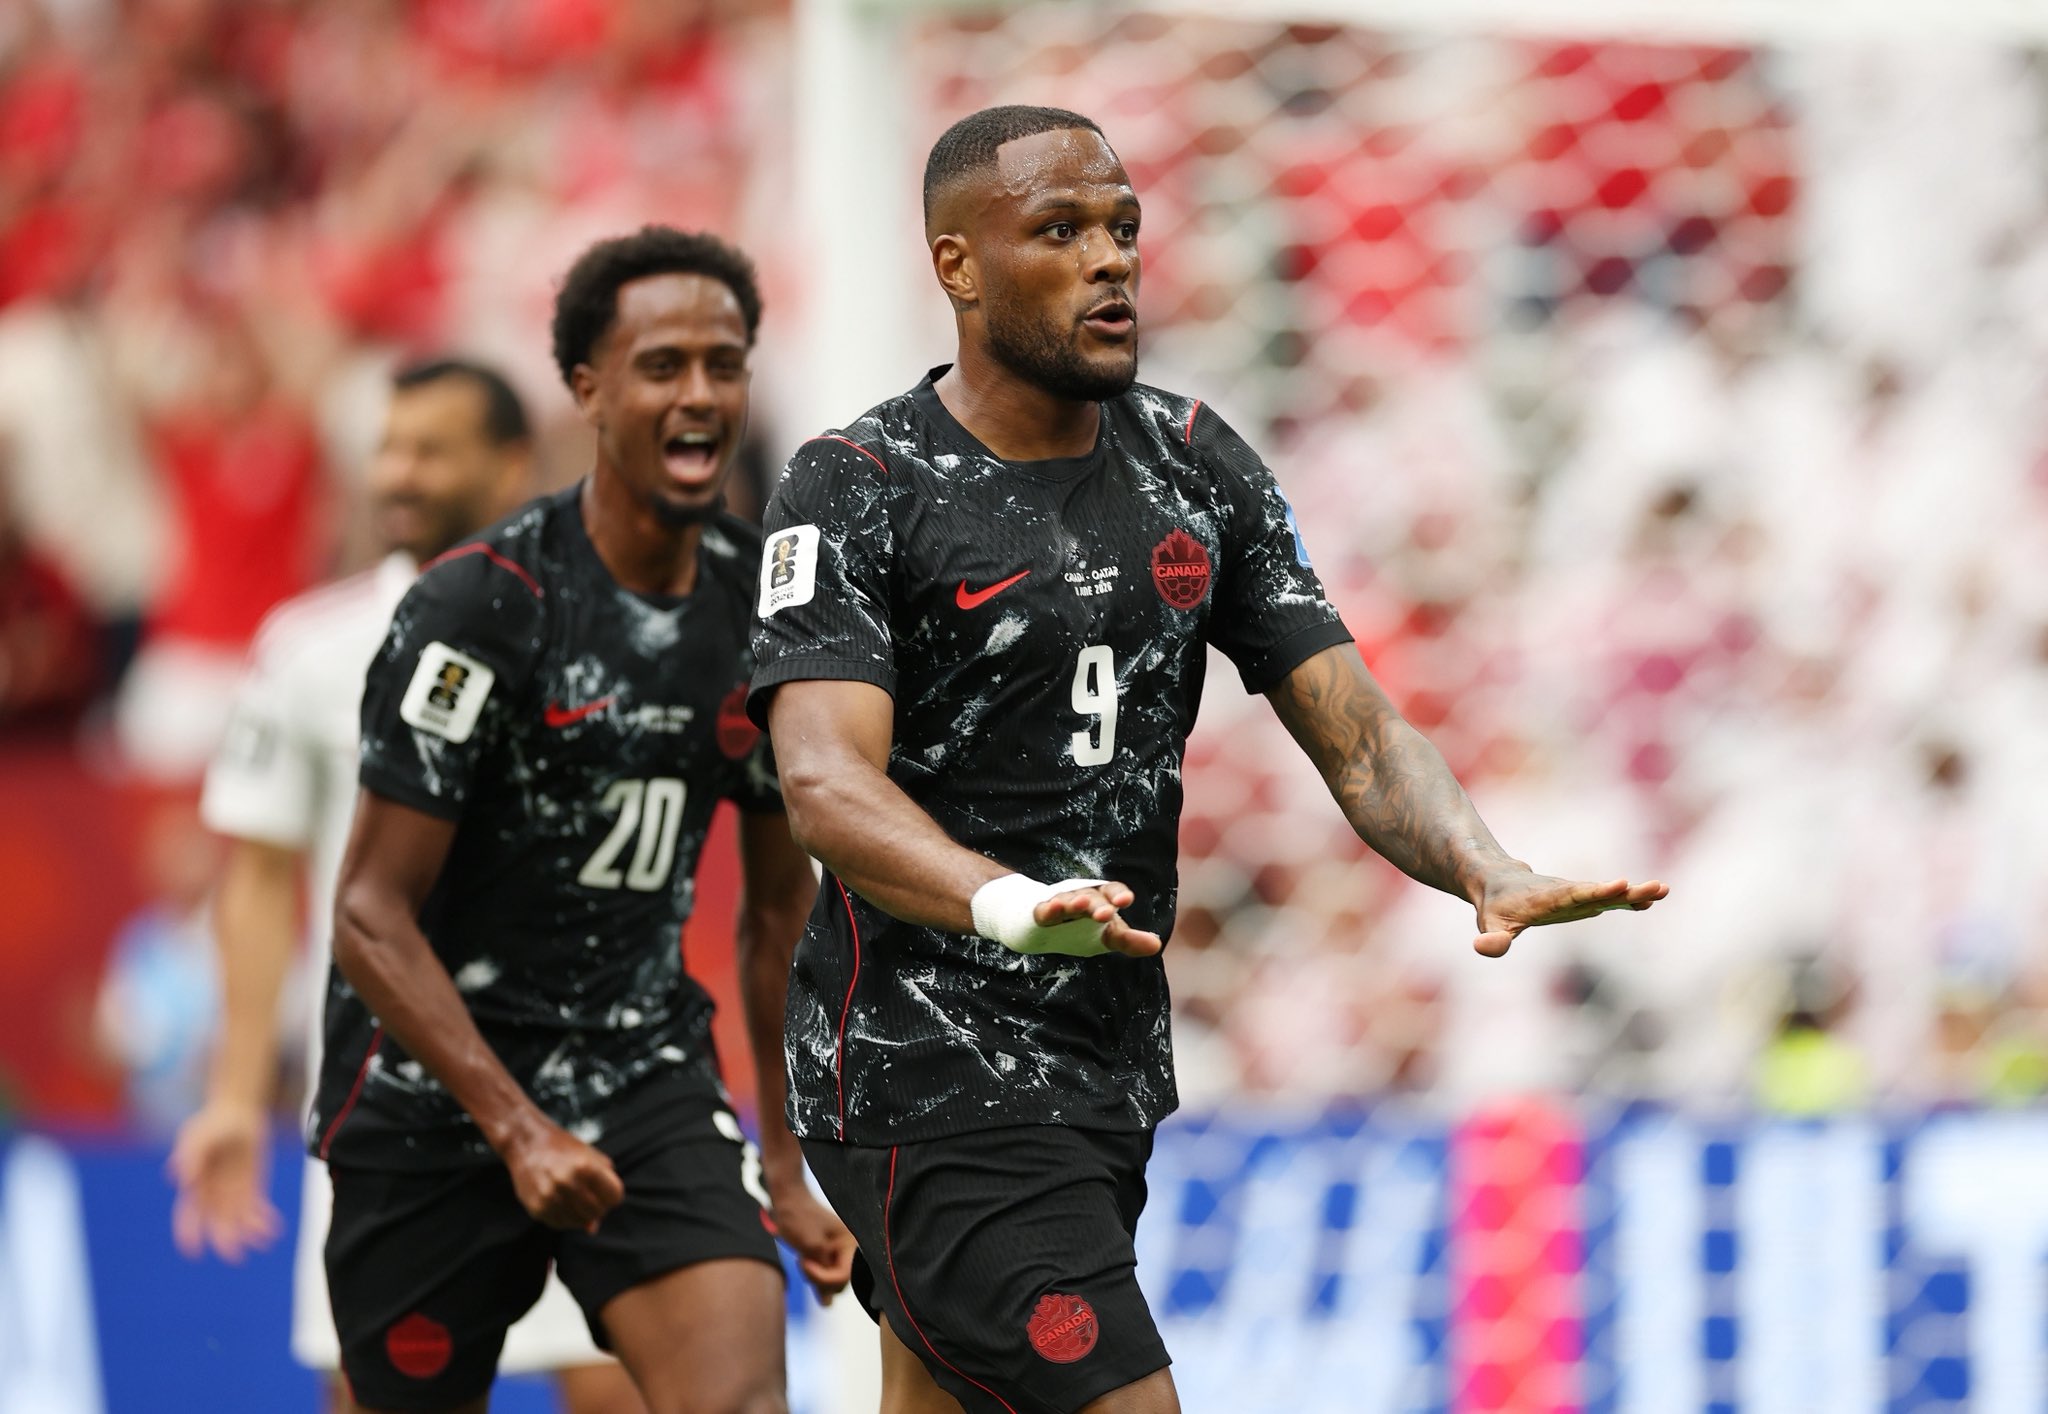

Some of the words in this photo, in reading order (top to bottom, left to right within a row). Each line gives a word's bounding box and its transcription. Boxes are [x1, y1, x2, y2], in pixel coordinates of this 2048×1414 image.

[1091, 565, 1119, 580] QATAR
[1156, 565, 1209, 579] CANADA
[1094, 581, 1113, 595] 2026
[1071, 645, 1118, 767] 9
[577, 776, 688, 892] 20
[1036, 1311, 1093, 1347] CANADA
